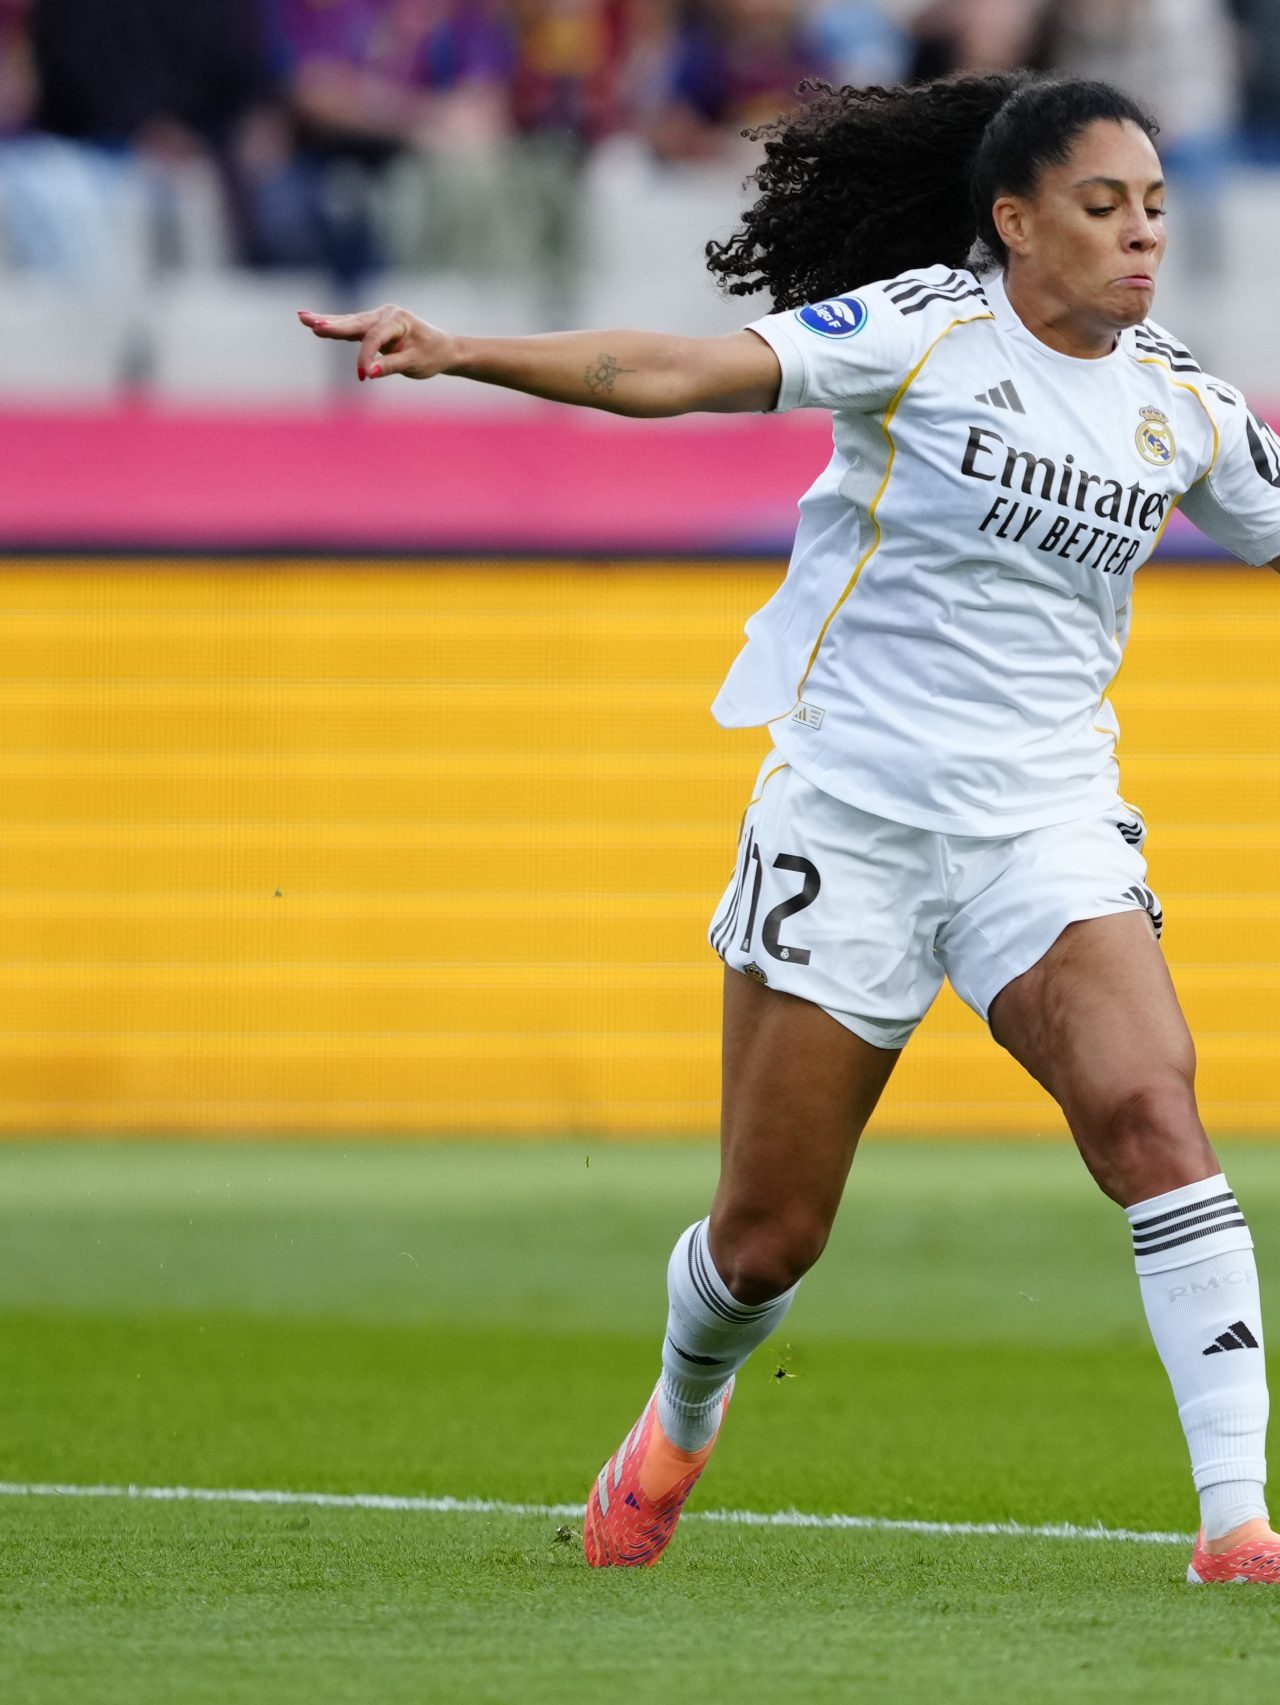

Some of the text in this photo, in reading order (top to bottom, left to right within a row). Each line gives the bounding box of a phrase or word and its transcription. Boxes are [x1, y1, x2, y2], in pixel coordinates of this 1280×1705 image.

[961, 426, 1169, 533] Emirates
[978, 496, 1141, 577] FLY BETTER
[739, 842, 822, 966] 12
